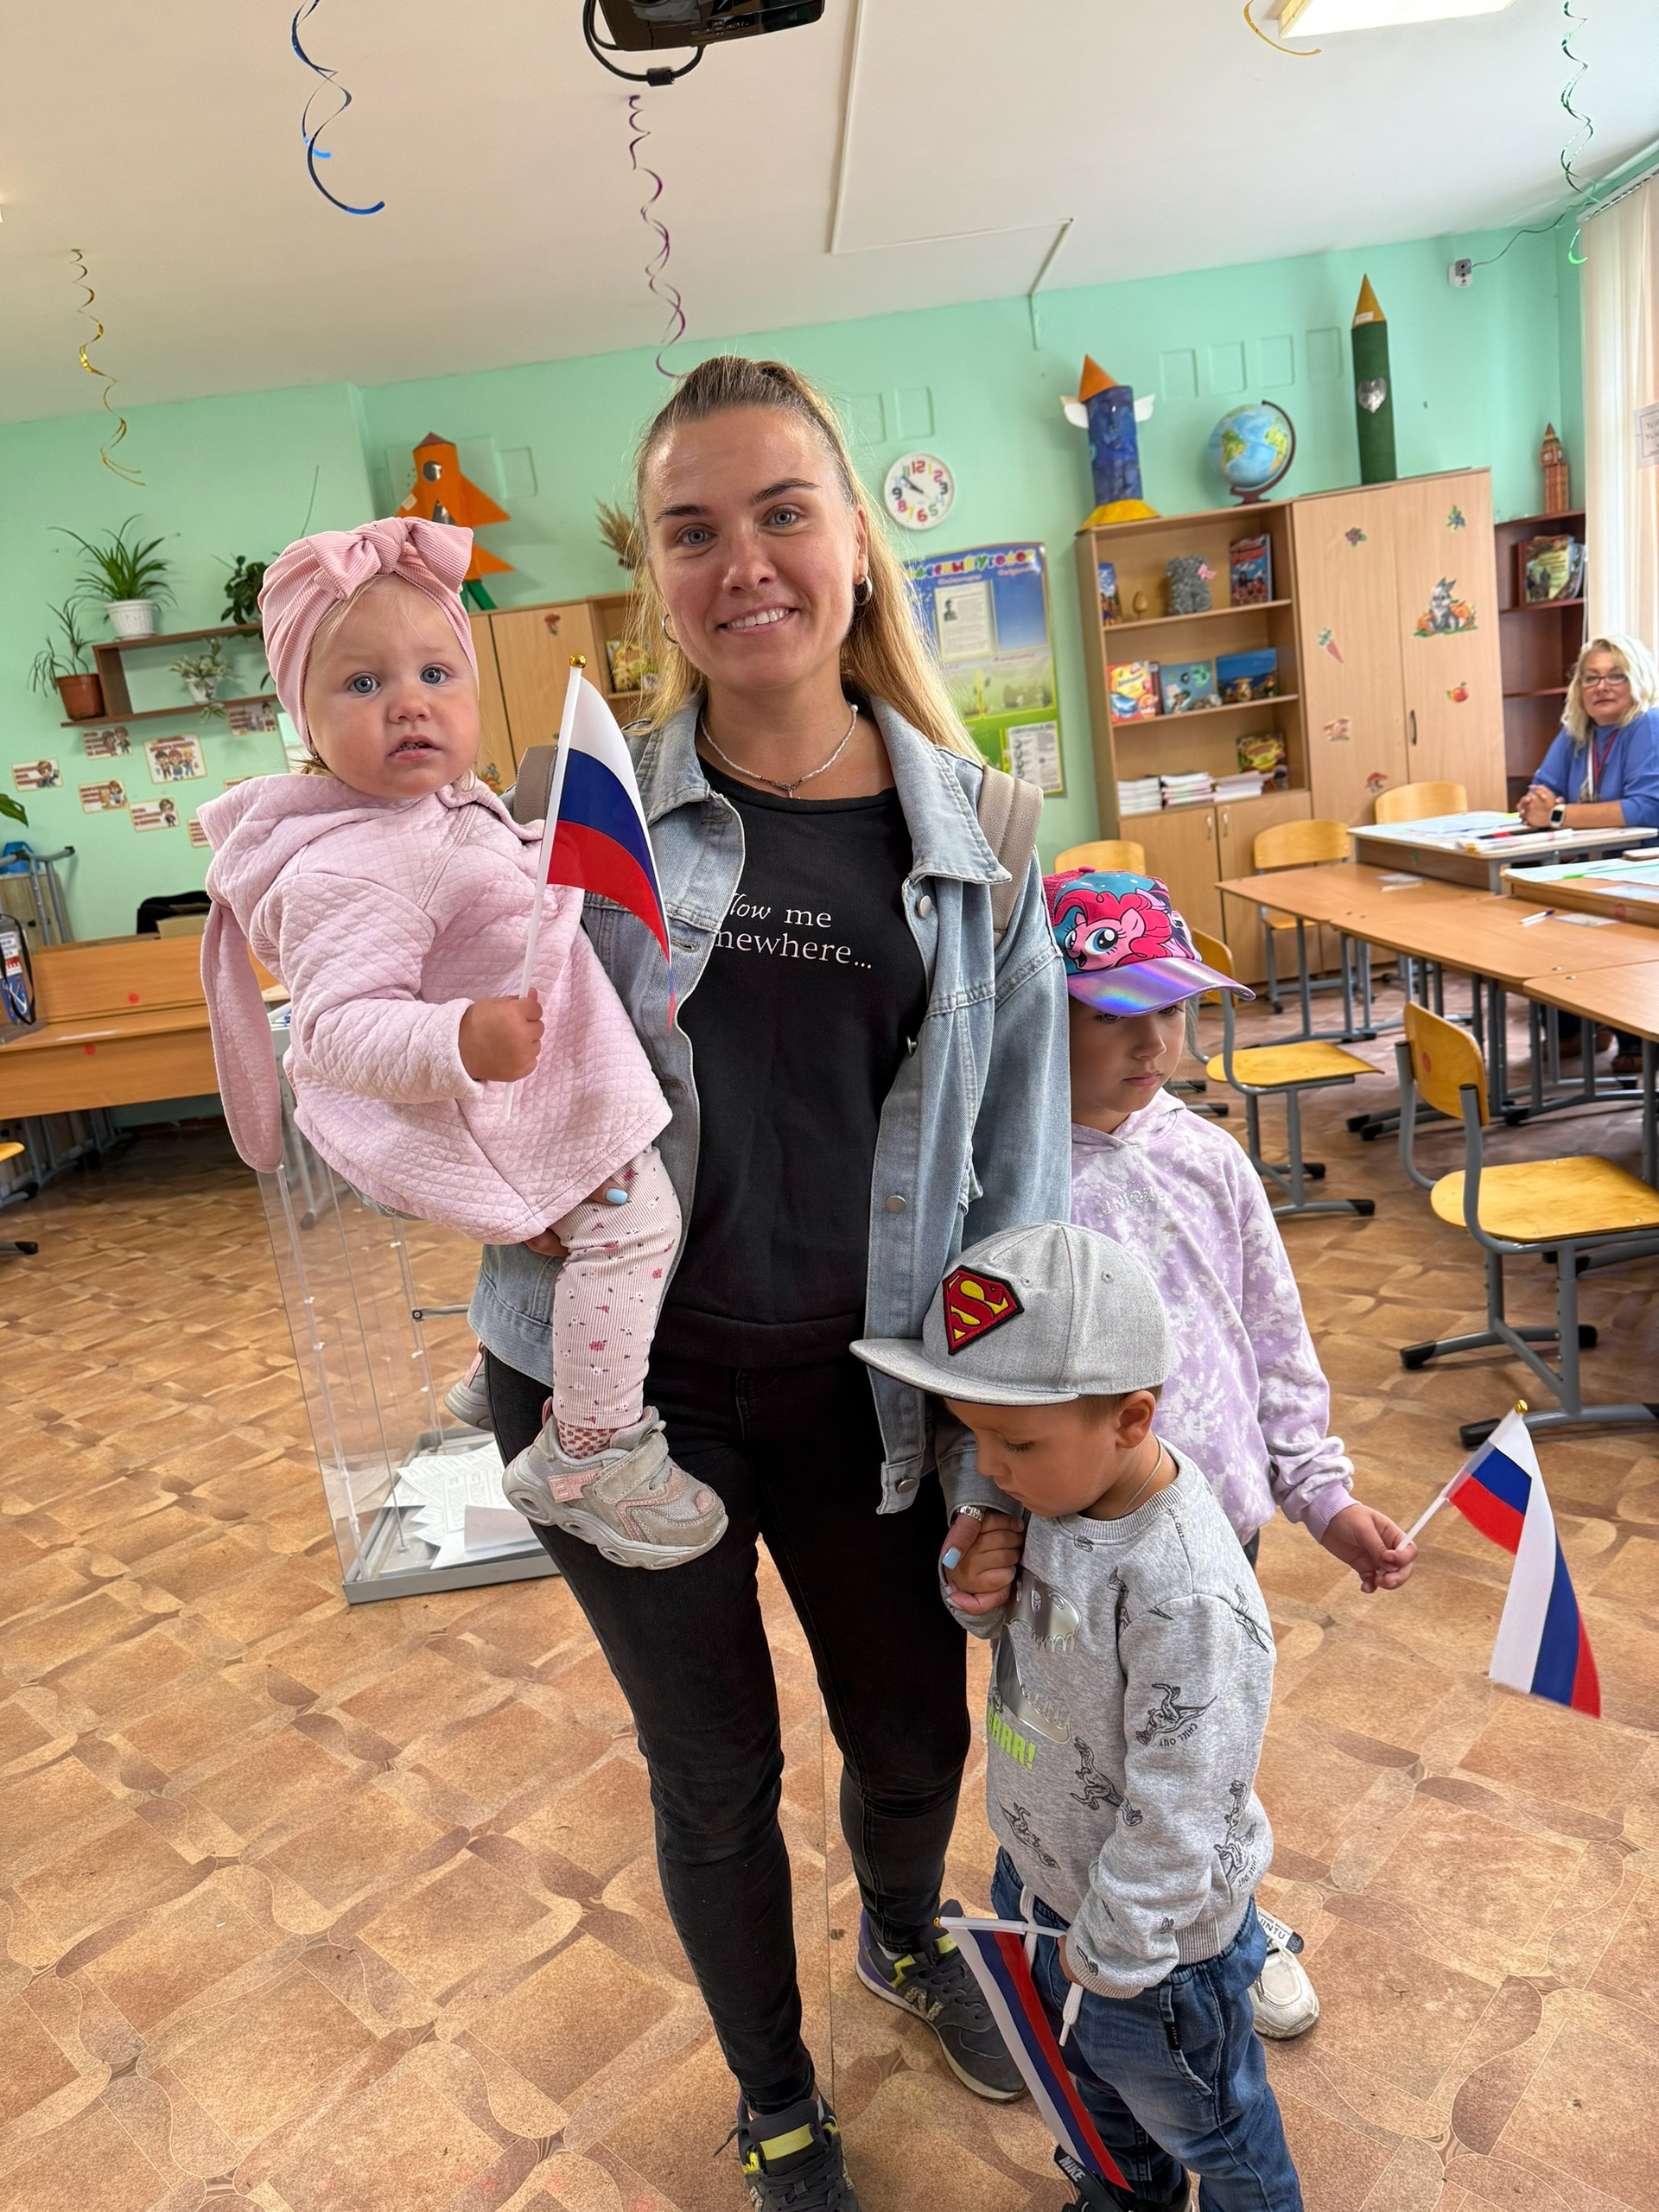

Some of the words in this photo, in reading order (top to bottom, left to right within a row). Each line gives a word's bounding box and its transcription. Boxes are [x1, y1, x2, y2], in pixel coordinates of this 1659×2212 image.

[912, 461, 925, 474] 12
[934, 470, 944, 483] 2
[892, 487, 903, 500] 9
[939, 482, 949, 495] 3
[899, 499, 906, 512] 8
[929, 503, 938, 517] 5
[907, 506, 914, 520] 7
[917, 508, 928, 522] 6
[785, 908, 832, 928] me
[1177, 1722, 1198, 1742] CHILL
[1159, 1738, 1177, 1747] OUT
[1058, 2155, 1086, 2183] NIKE
